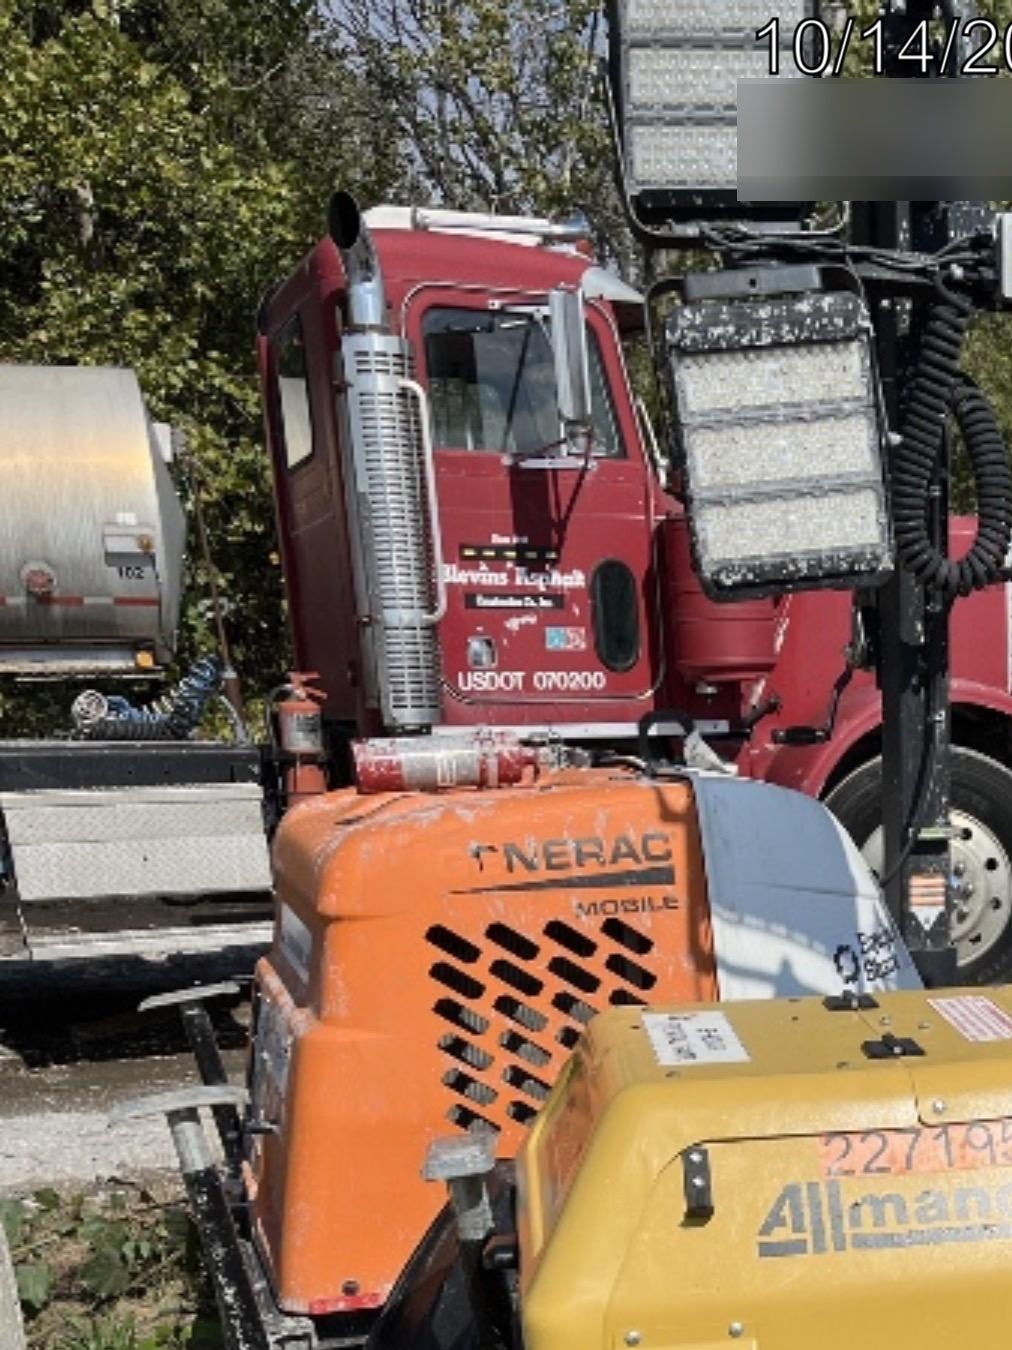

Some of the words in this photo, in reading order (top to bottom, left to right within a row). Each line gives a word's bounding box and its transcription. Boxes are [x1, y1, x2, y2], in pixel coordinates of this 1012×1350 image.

[118, 566, 145, 581] 102
[457, 671, 526, 692] USDOT
[533, 671, 607, 691] 070200
[575, 896, 679, 918] MOBILE
